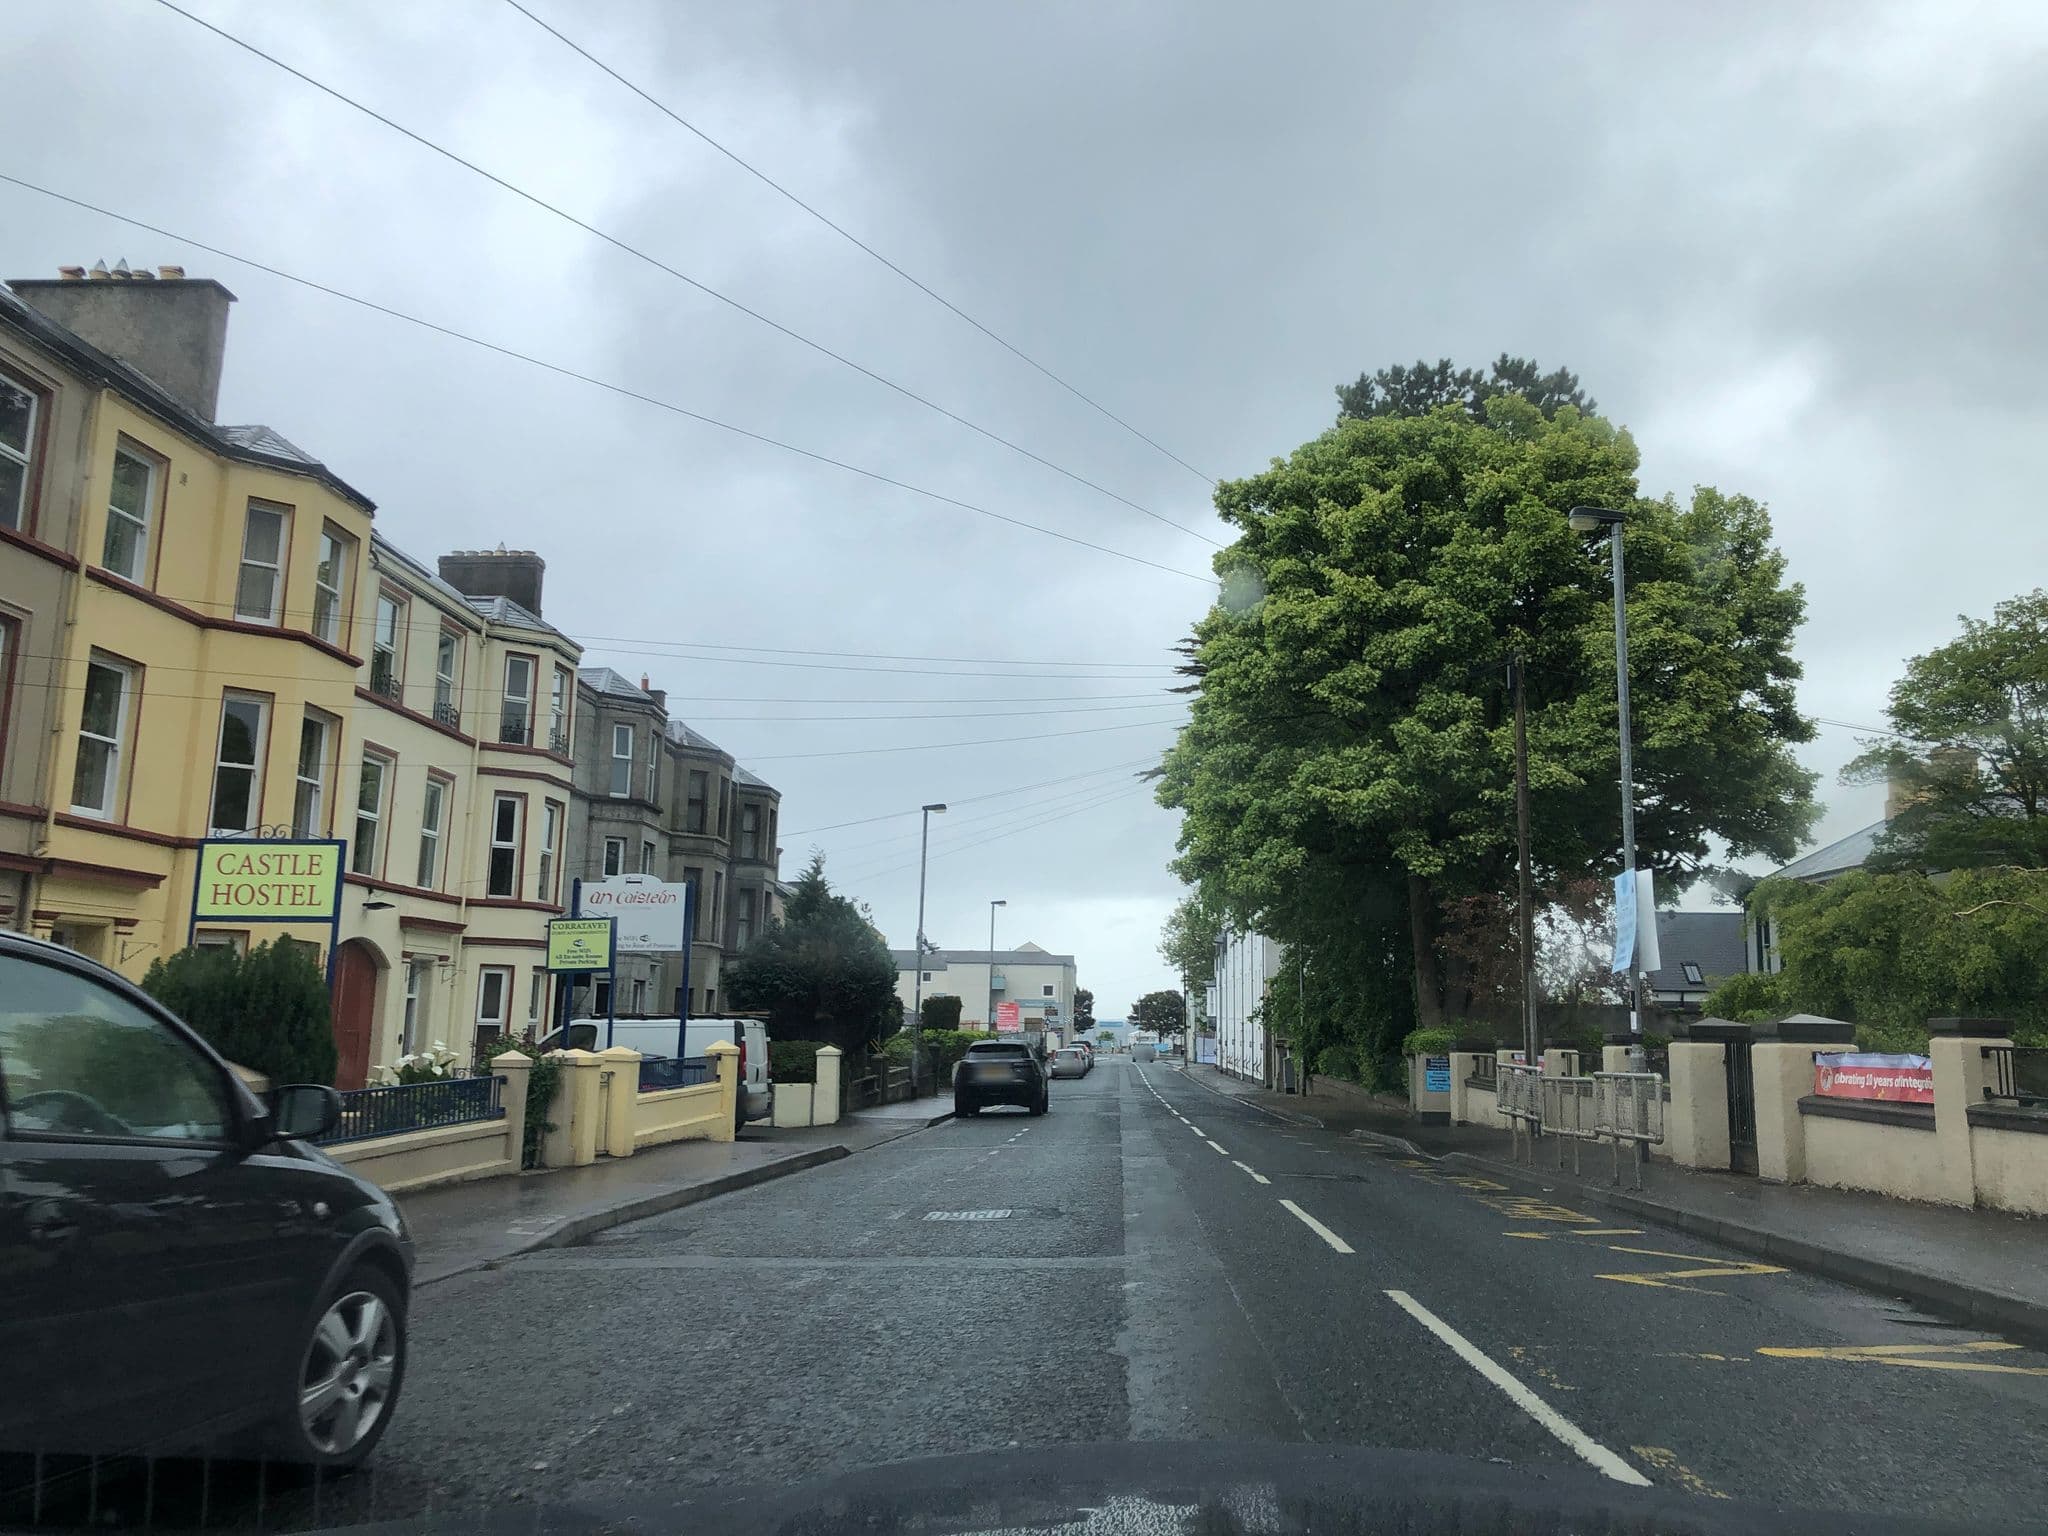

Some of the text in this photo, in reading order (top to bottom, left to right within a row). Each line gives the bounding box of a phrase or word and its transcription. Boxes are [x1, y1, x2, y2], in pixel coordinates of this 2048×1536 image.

[216, 852, 323, 876] CASTLE
[210, 883, 322, 906] HOSTEL
[1873, 1075, 1894, 1090] years
